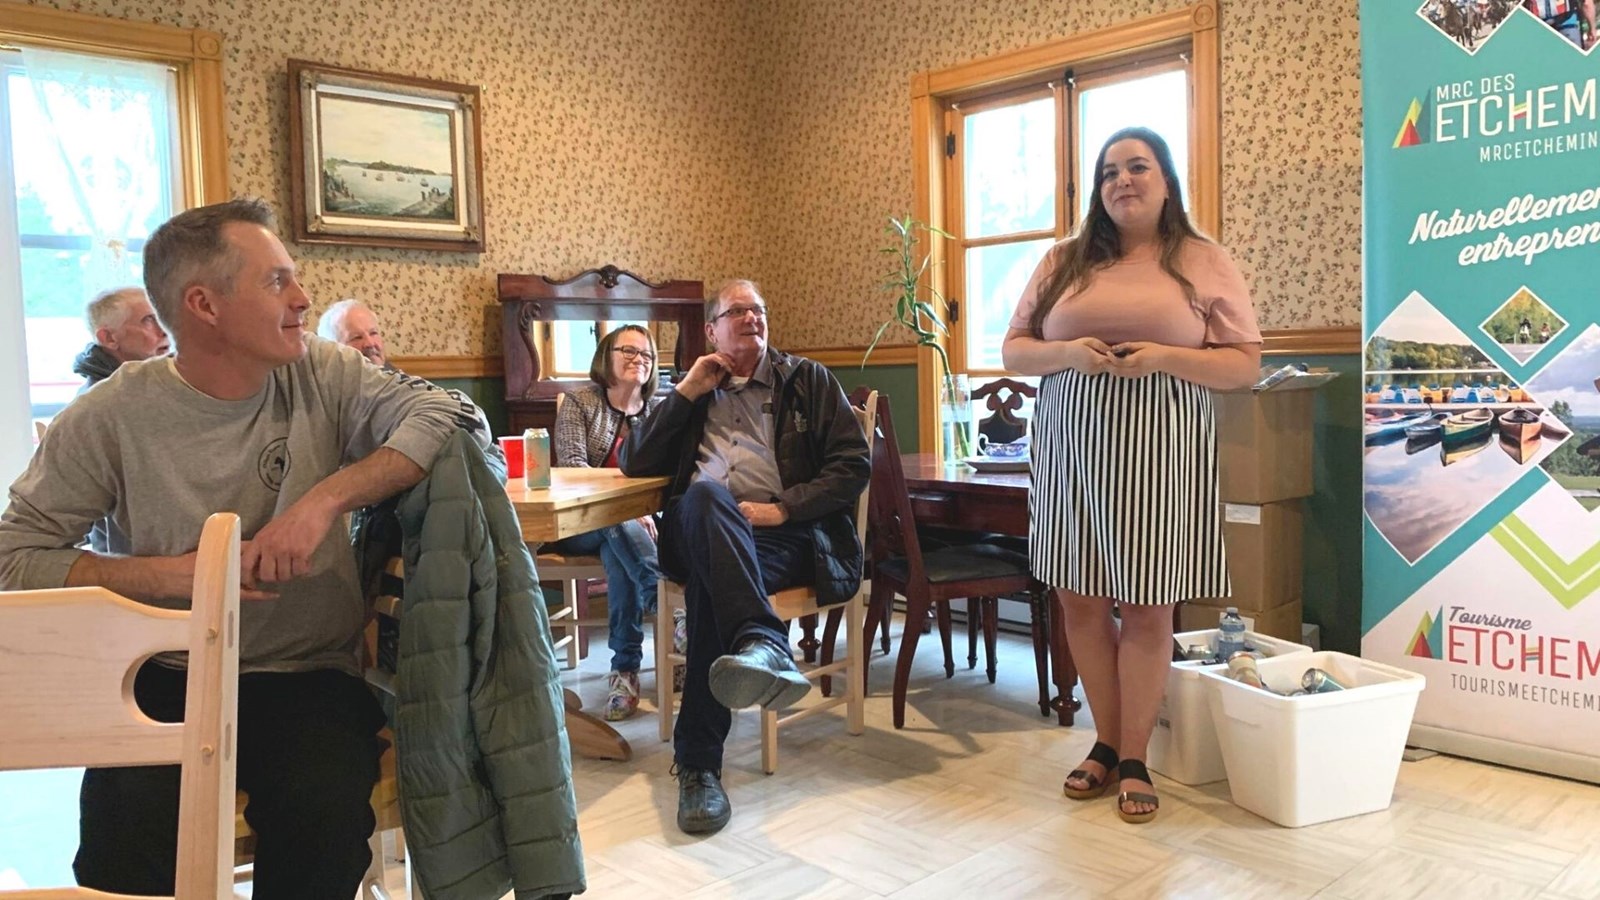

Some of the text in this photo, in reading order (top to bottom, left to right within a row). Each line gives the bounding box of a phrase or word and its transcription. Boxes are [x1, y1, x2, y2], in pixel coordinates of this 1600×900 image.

[1437, 73, 1515, 102] MRC DES
[1449, 606, 1532, 631] Tourisme
